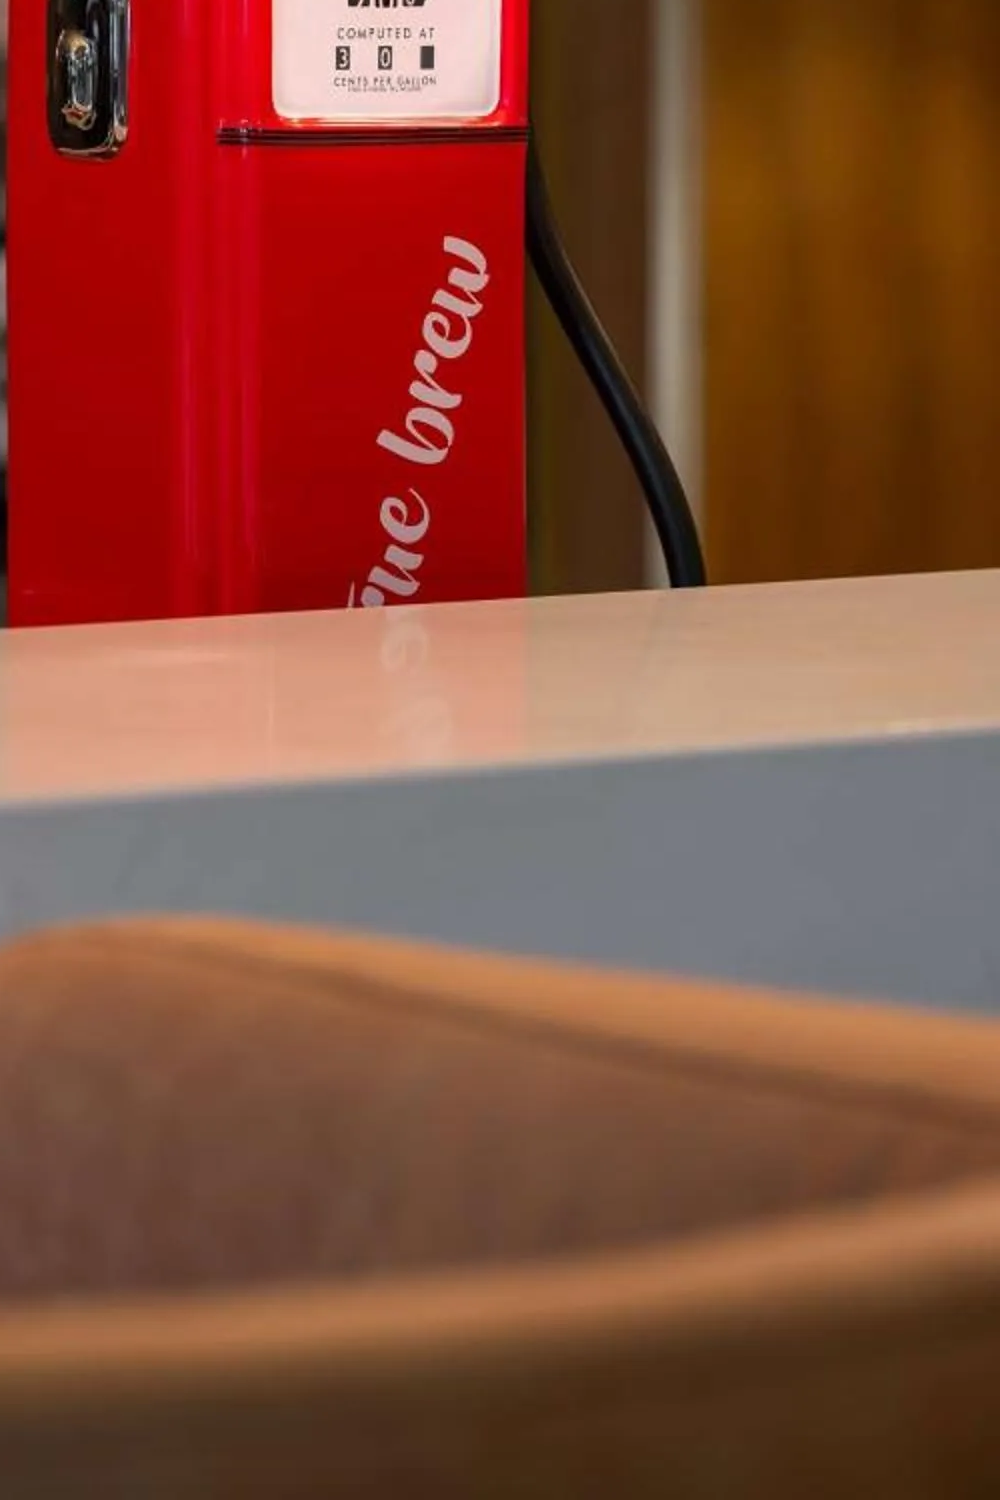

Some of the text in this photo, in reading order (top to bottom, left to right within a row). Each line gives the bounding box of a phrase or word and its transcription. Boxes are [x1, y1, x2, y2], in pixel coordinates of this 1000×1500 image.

[337, 27, 435, 40] COMPUTED AT
[334, 76, 437, 87] CENTS PER GALLON
[346, 235, 490, 612] ue brew
